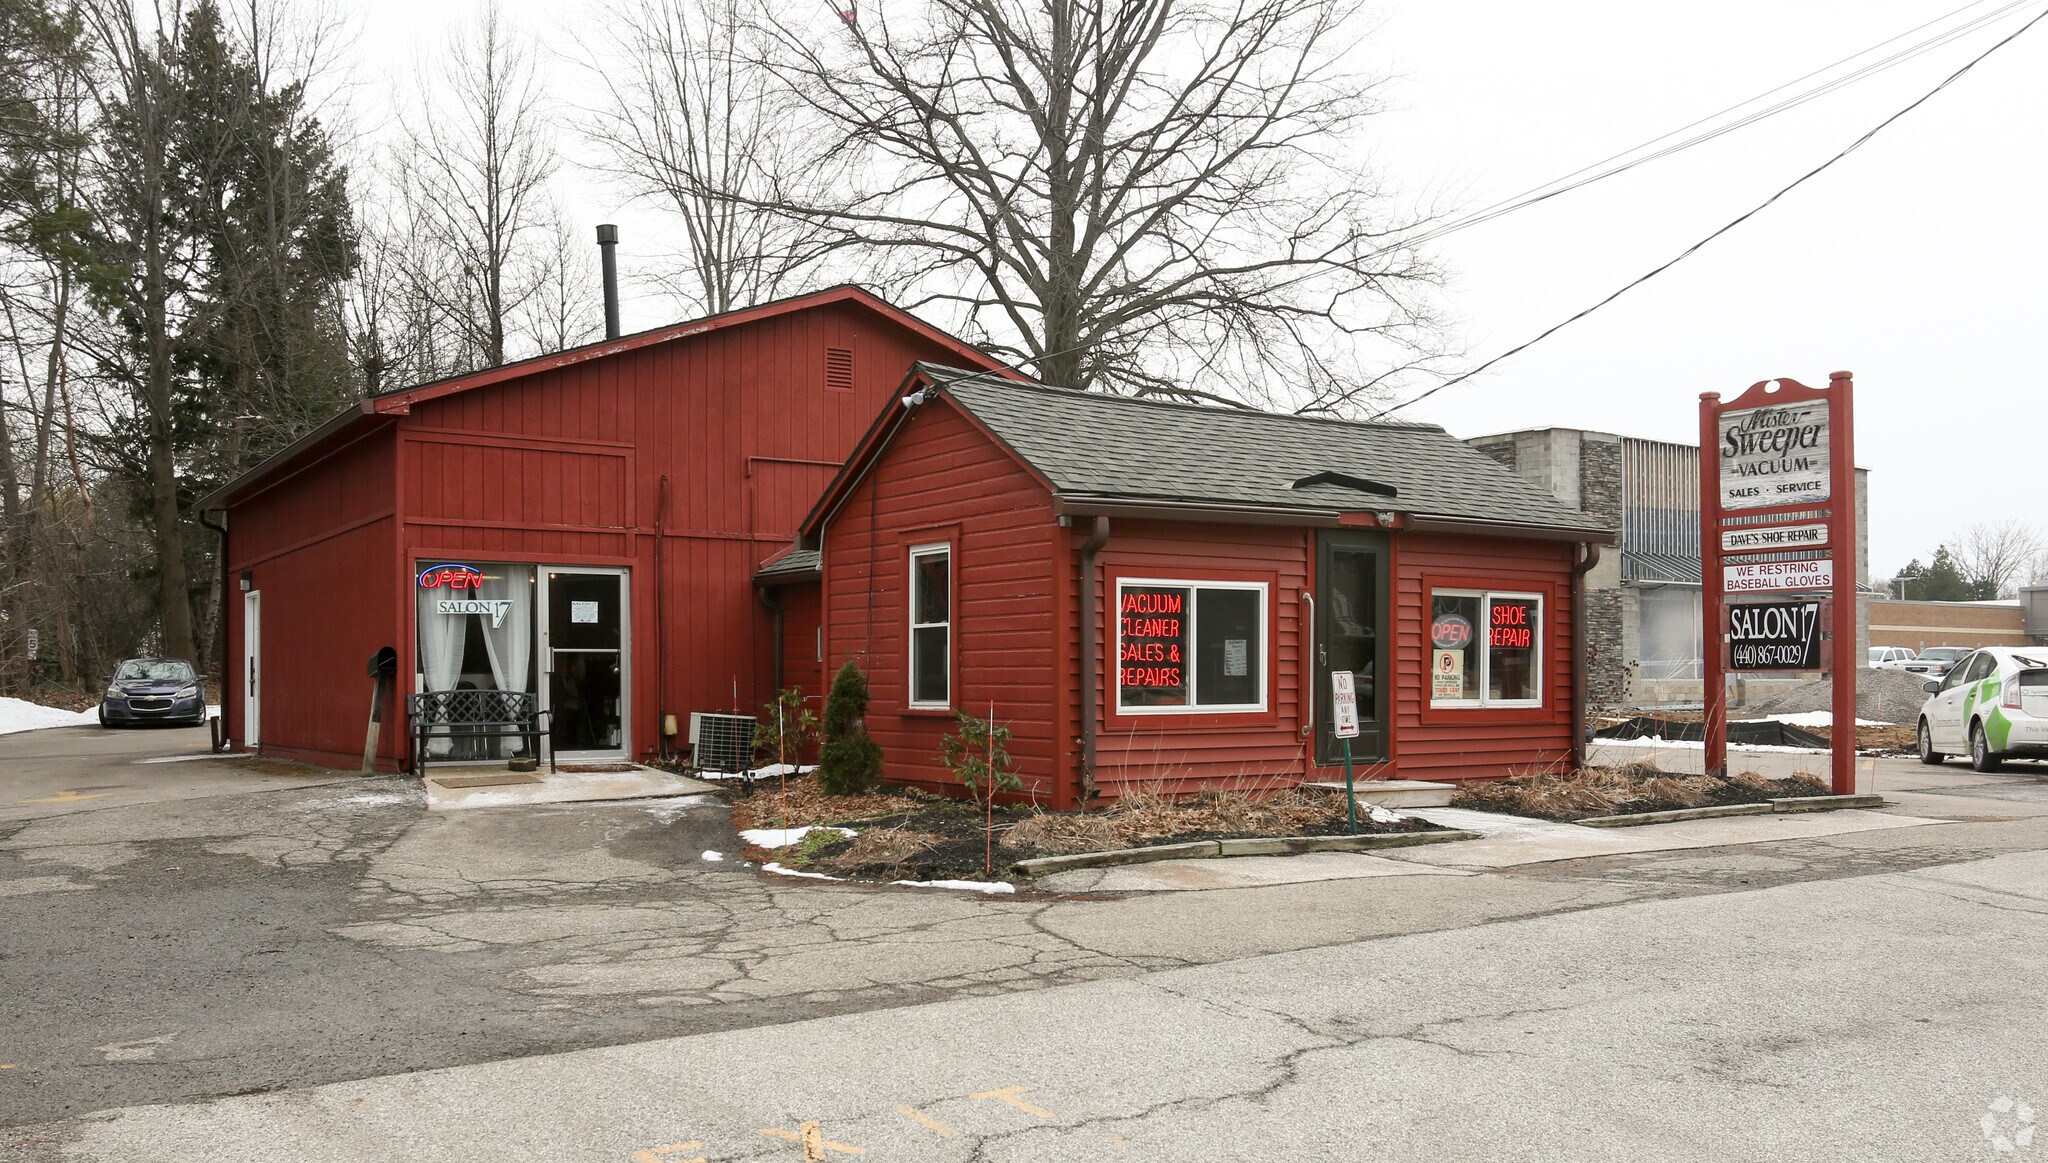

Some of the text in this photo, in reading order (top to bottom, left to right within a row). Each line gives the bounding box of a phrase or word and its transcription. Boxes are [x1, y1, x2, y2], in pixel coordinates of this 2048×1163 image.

[1722, 424, 1823, 458] Sweeper
[1729, 481, 1822, 498] SALES SERVICE
[1730, 529, 1818, 546] DAVE'S SHOE REPAIR
[1736, 562, 1818, 576] WE RESTRING
[422, 571, 484, 589] OPEN
[1727, 575, 1830, 590] BASEBALL GLOVES
[439, 601, 513, 627] SALON 17
[1492, 606, 1527, 625] SHOE
[1121, 617, 1179, 637] CLEANER
[1431, 623, 1471, 641] OPEN
[1731, 603, 1818, 665] SALON 17
[1489, 628, 1530, 648] REPAIR
[1121, 643, 1180, 663] SALES &
[1734, 644, 1802, 667] (440) 867-0029
[1121, 667, 1180, 686] REPAIRS
[1338, 678, 1348, 690] NO
[1335, 692, 1355, 704] PARKING
